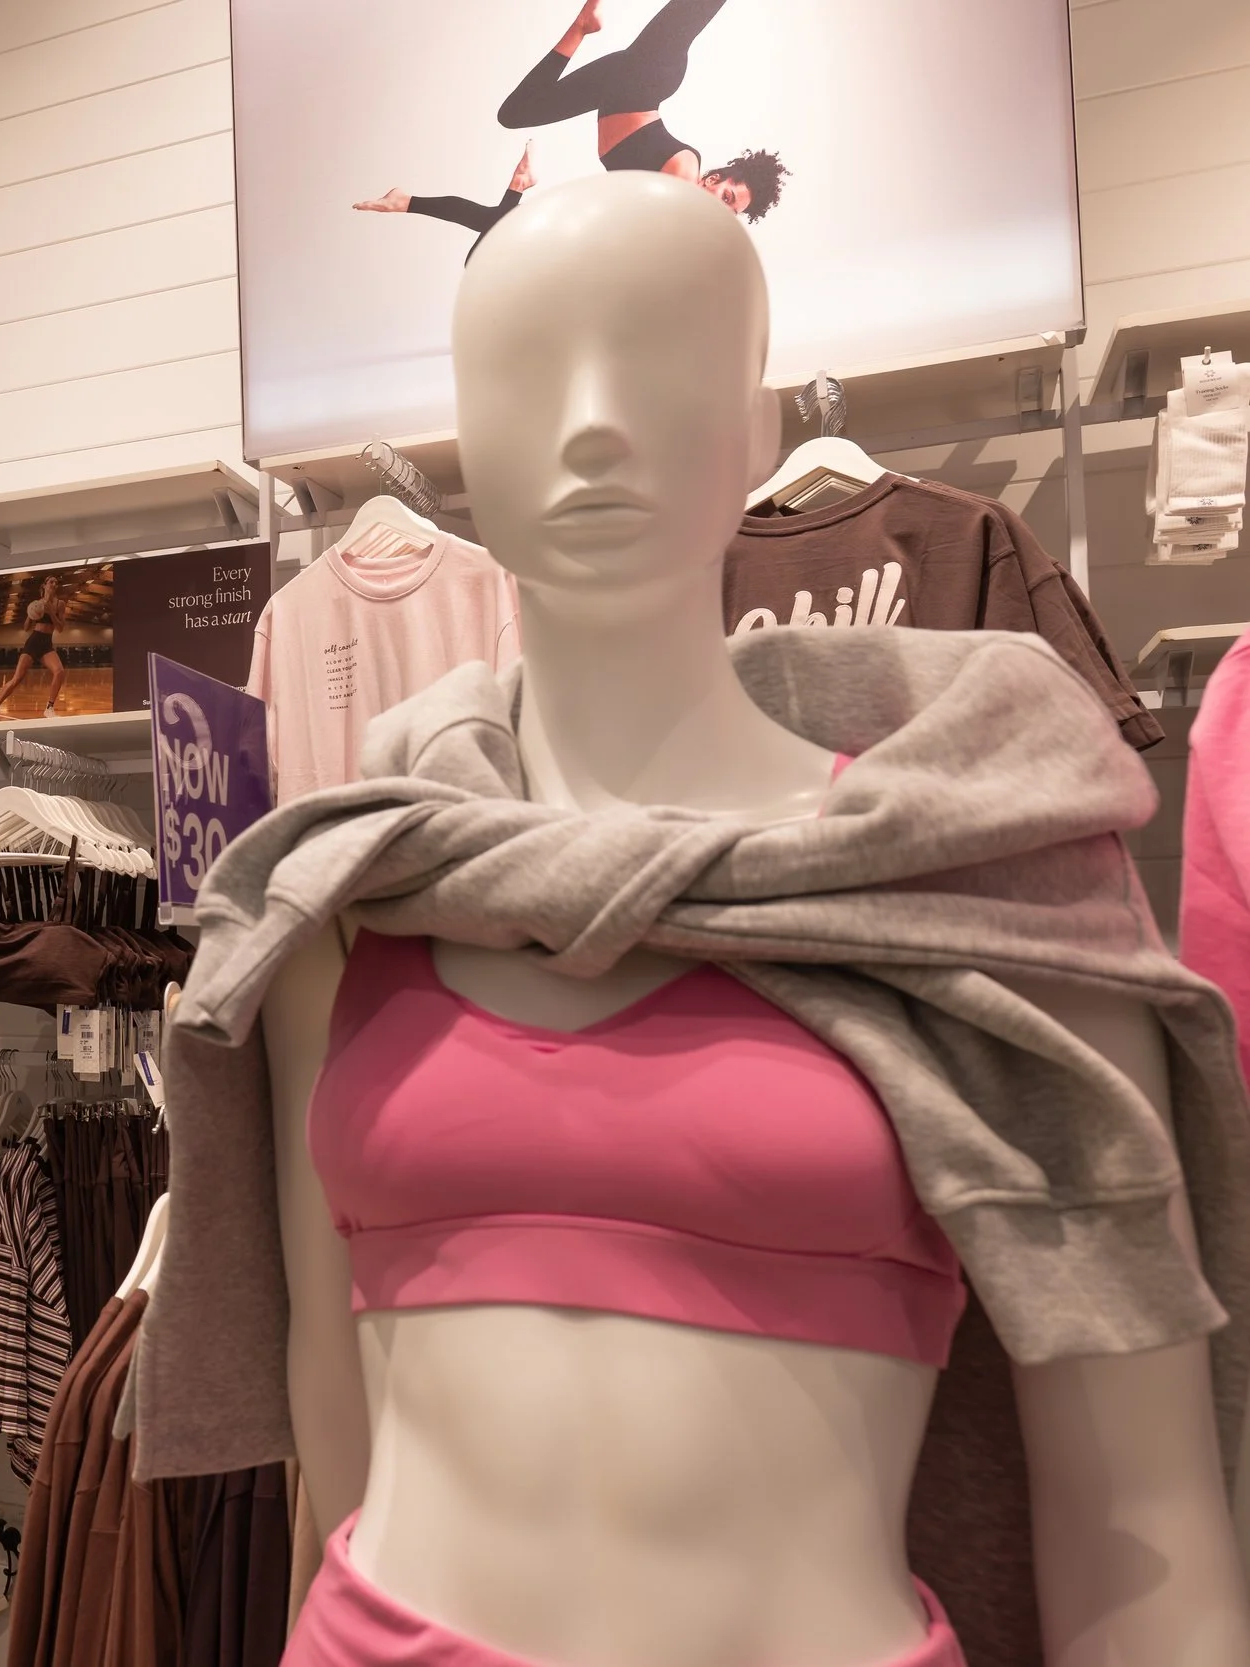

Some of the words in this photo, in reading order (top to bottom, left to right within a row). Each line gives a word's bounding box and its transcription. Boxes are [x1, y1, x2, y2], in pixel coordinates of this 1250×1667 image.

[213, 567, 252, 583] Every
[168, 593, 213, 609] strong
[216, 585, 251, 604] finish
[185, 614, 209, 629] has
[211, 616, 220, 627] a
[221, 611, 252, 625] start
[161, 733, 230, 806] NOW
[164, 802, 227, 890] $30
